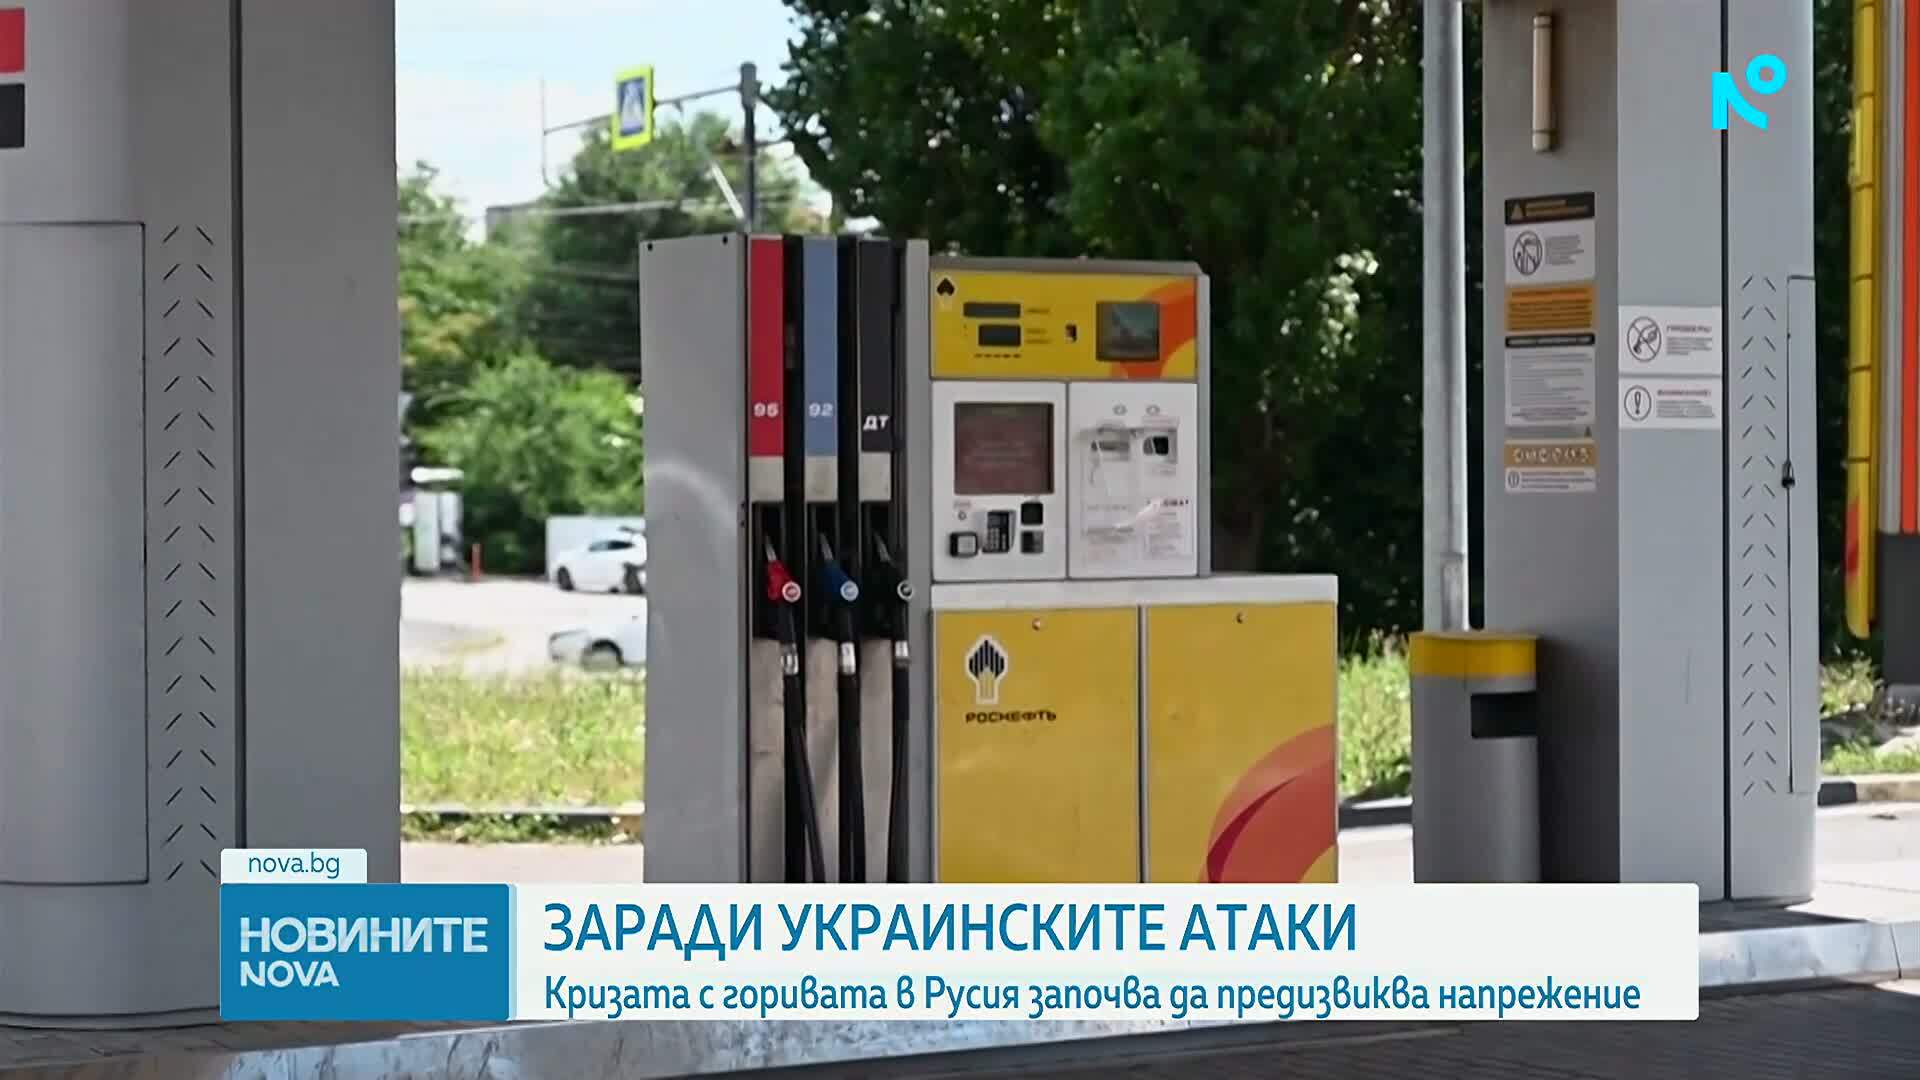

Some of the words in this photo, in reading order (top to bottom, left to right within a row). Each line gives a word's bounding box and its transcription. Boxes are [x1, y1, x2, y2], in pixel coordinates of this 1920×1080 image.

[753, 402, 779, 417] 95
[808, 402, 834, 417] 92
[863, 415, 890, 431] ДТ
[965, 710, 1057, 724] РОСНЕФТЬ
